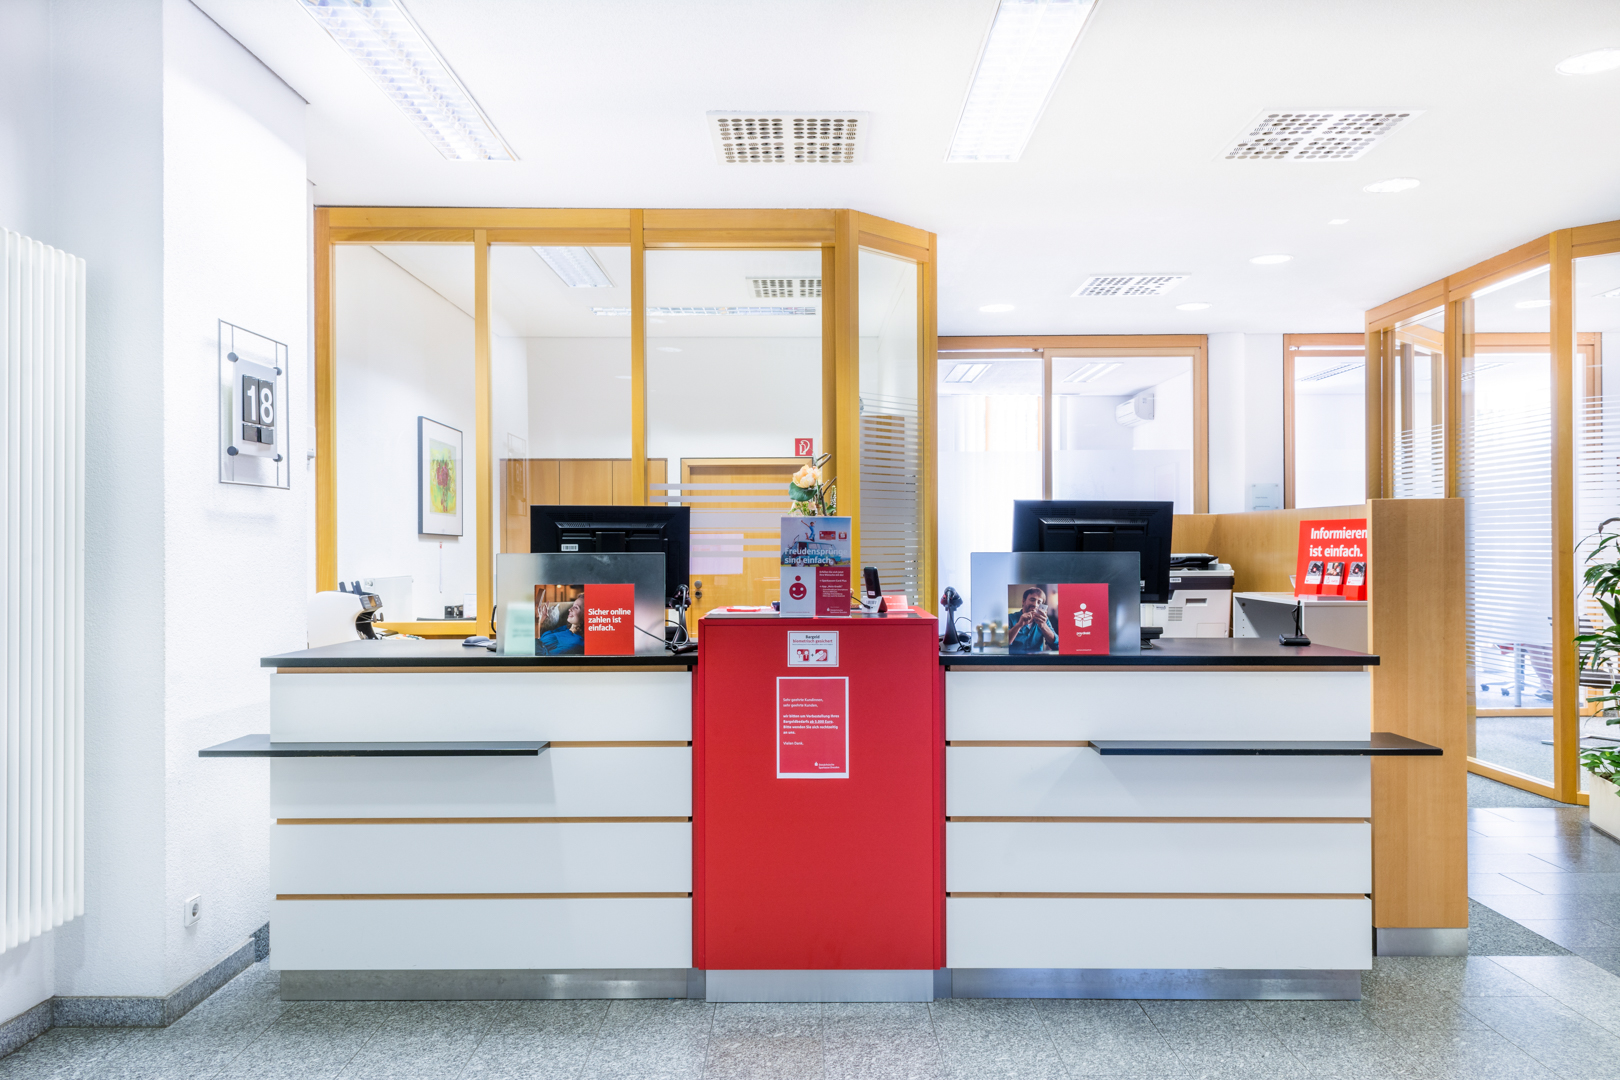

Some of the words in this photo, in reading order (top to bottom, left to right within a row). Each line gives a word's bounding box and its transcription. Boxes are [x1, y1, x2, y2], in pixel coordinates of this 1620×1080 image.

[247, 385, 273, 423] 18
[1310, 526, 1367, 539] Informieren
[784, 548, 847, 556] Freudensprünge
[1309, 545, 1322, 557] ist
[1324, 544, 1363, 557] einfach.
